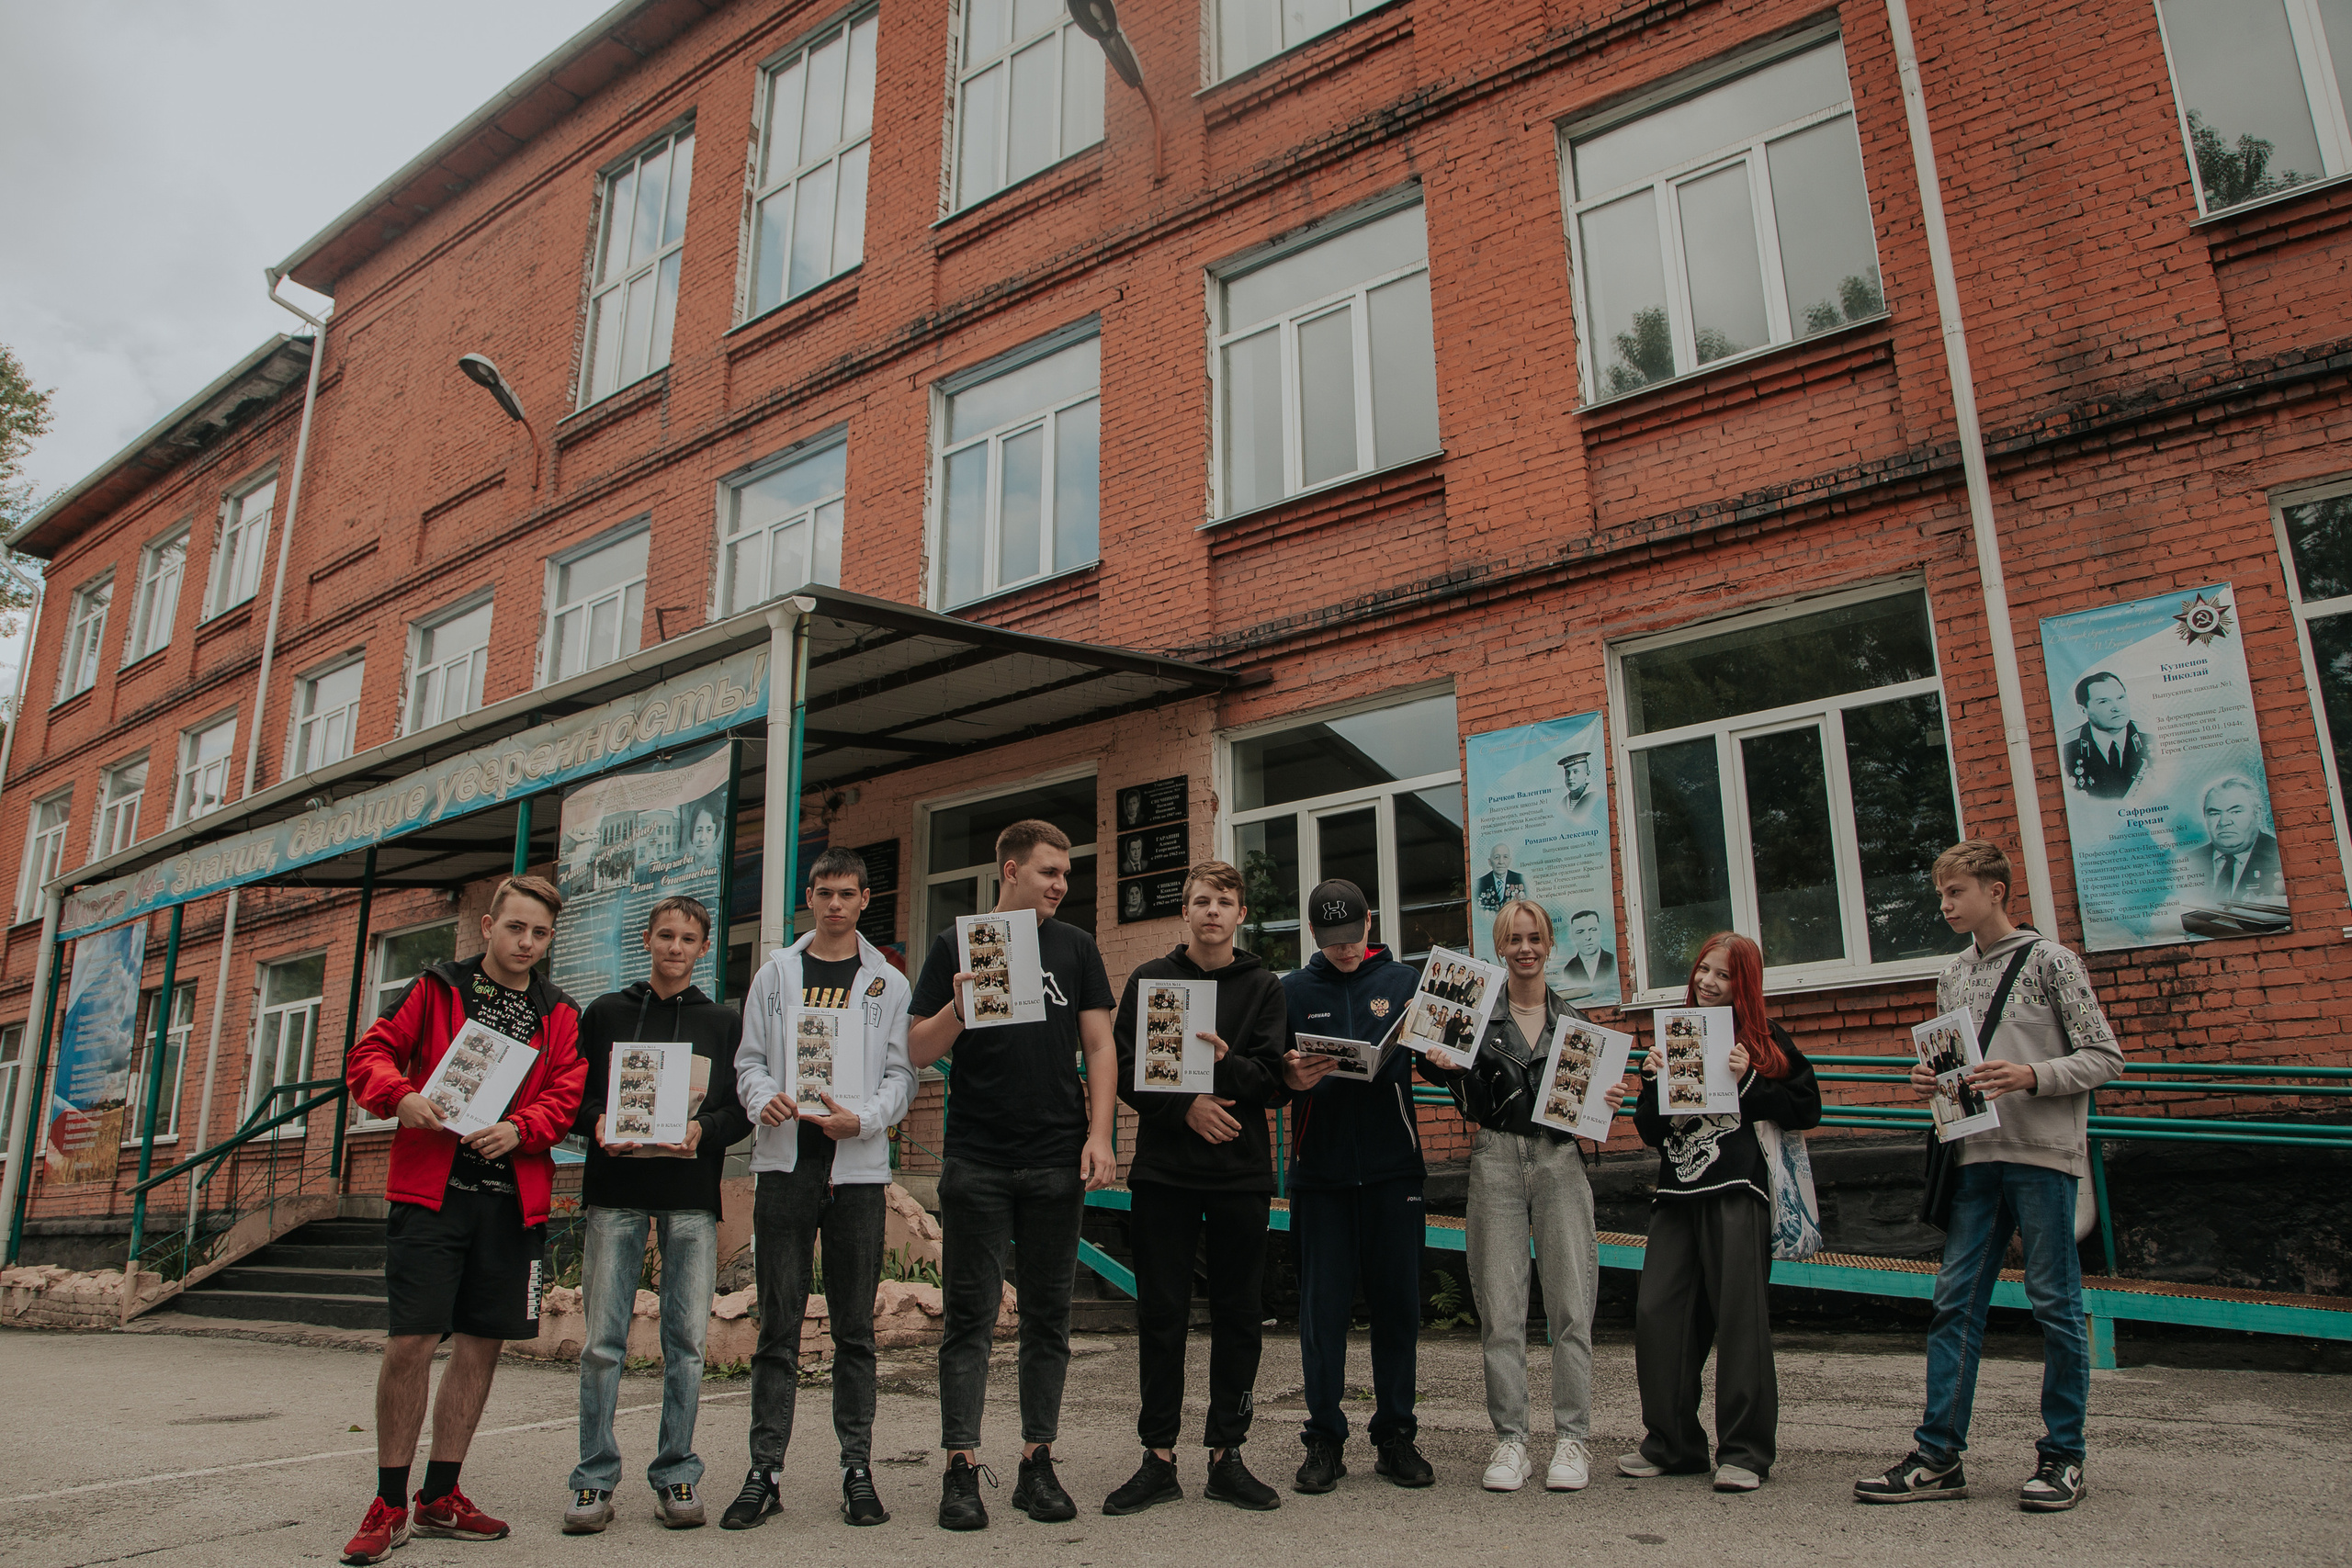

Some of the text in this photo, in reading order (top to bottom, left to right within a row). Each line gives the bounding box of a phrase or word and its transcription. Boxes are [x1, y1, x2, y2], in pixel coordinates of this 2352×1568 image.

[2160, 658, 2208, 671] Кузнецов
[2162, 666, 2209, 682] Николай
[2152, 680, 2232, 698] Выпускник школы №1
[2165, 709, 2216, 723] форсирование
[2217, 704, 2247, 712] Днепра,
[2156, 716, 2216, 729] подавление огня
[2158, 726, 2200, 739] противника
[2159, 731, 2222, 746] присвоено звание
[2182, 741, 2219, 751] Советского
[2220, 737, 2250, 745] Союза
[171, 837, 278, 896] Знания,
[288, 783, 427, 861] дающие
[429, 651, 769, 822] уверенность!
[1488, 788, 1551, 804] Рычков Валентин
[2117, 805, 2169, 817] Сафронов
[2126, 817, 2164, 828] Герман
[1524, 829, 1598, 845] Ромашко Александр
[2108, 831, 2148, 840] Выпускник
[2149, 827, 2174, 835] школы
[2078, 839, 2199, 859] Профессор Санкт-Петербургского
[2079, 852, 2165, 868] университета. Академик
[2080, 863, 2131, 874] гуманитарных
[2152, 856, 2188, 866] Почётный
[2081, 874, 2120, 883] гражданин
[2090, 883, 2119, 891] феврале
[2155, 874, 2184, 882] комсорг
[2186, 872, 2204, 880] роты
[2089, 890, 2120, 899] разведке
[2141, 884, 2173, 893] получает
[2085, 899, 2115, 908] ранение.
[2118, 903, 2147, 912] орденов
[2148, 899, 2179, 908] Красной
[2142, 909, 2167, 918] Почёта
[1590, 1116, 1607, 1125] КЛАСС
